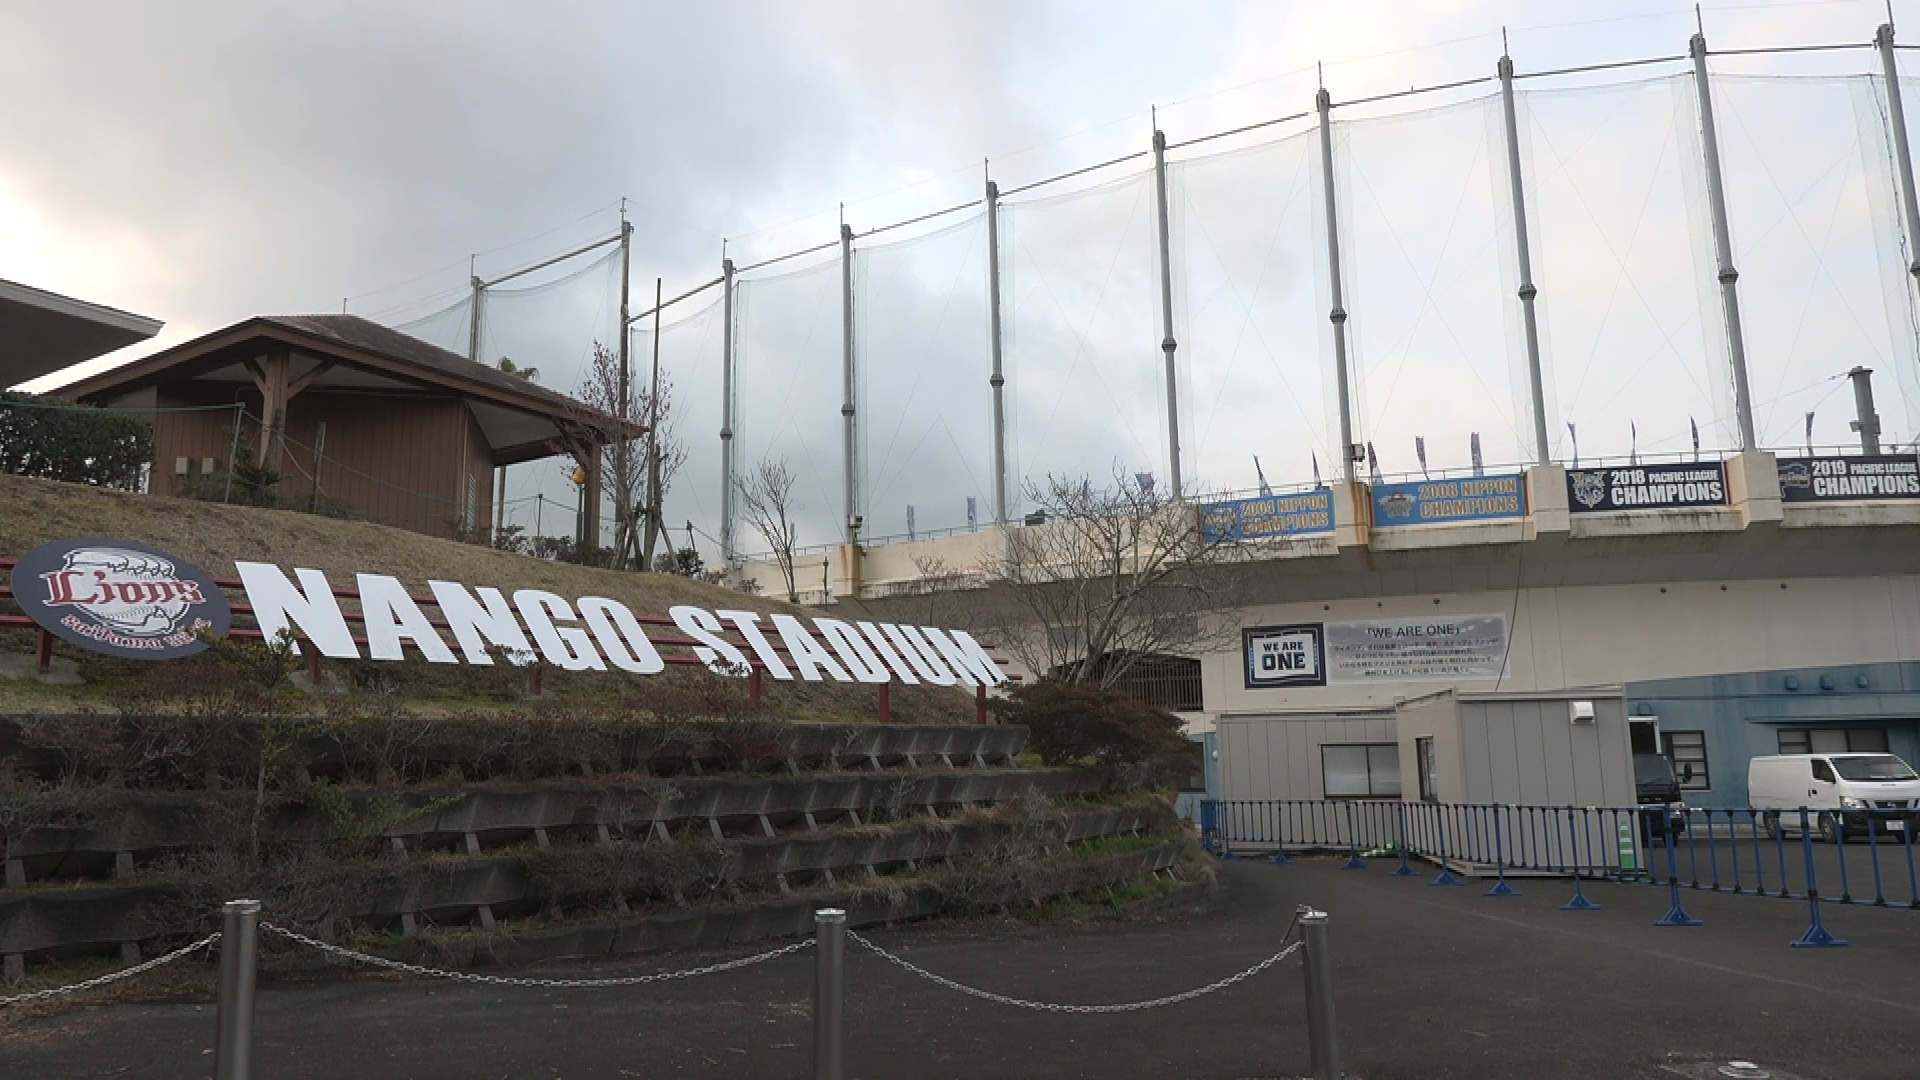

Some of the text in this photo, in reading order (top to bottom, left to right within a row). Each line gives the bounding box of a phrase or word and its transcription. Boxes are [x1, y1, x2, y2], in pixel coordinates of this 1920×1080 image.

[1611, 470, 1719, 485] 2018 PACIFIC LEAGUE
[1811, 460, 1917, 476] 2019 PACIFIC LEAGUE
[1418, 478, 1517, 501] 2008 NIPPON
[1611, 482, 1722, 505] CHAMPIONS
[1813, 474, 1920, 496] CHAMPIONS
[1241, 501, 1275, 517] 2004
[1278, 495, 1328, 513] NIPPON
[1420, 495, 1519, 518] CHAMPIONS
[1242, 512, 1329, 535] CHAMPIONS
[235, 562, 1009, 686] NANGO STADIUM
[1396, 626, 1423, 637] ARE
[1262, 641, 1303, 653] WE ARE
[1261, 651, 1306, 671] ONE
